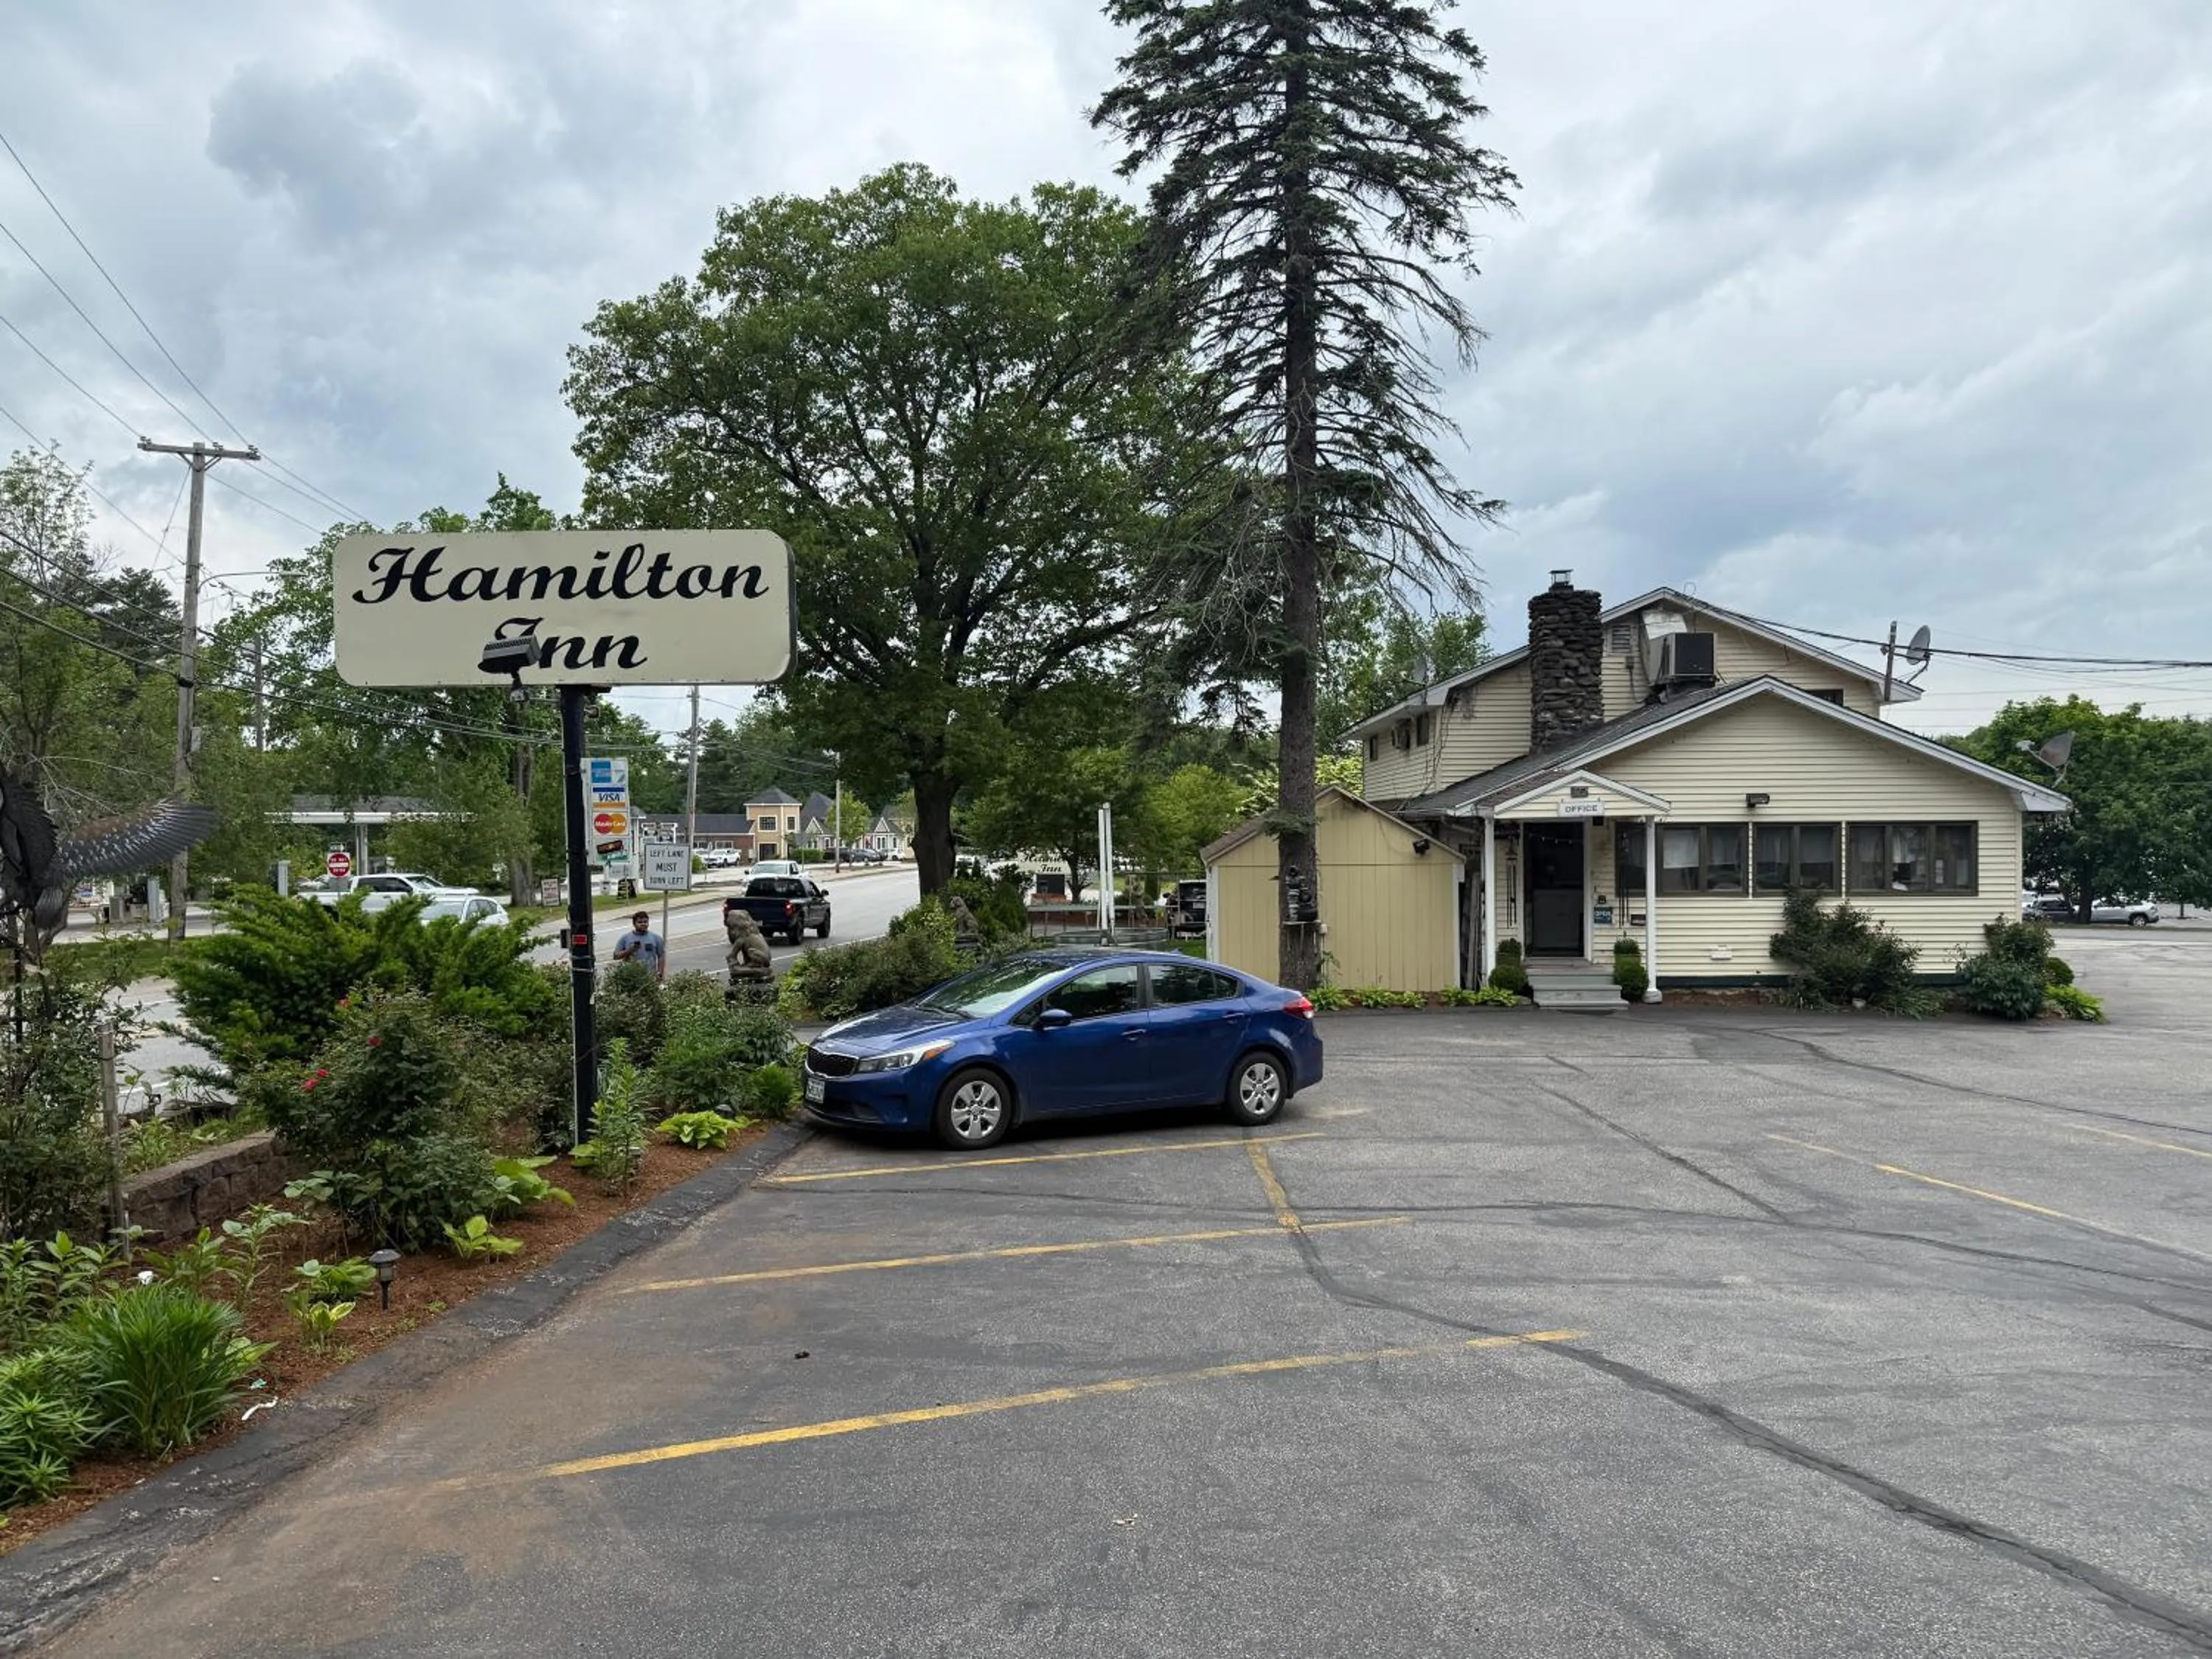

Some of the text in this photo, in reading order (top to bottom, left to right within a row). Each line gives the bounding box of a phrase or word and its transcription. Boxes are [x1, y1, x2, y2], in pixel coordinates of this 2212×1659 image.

[352, 543, 769, 604] Hamilton
[599, 793, 620, 801] VISA
[1565, 804, 1598, 813] OFFICE
[650, 849, 684, 858] LEFT LANE
[655, 862, 677, 872] MUST
[667, 877, 684, 885] LEFT
